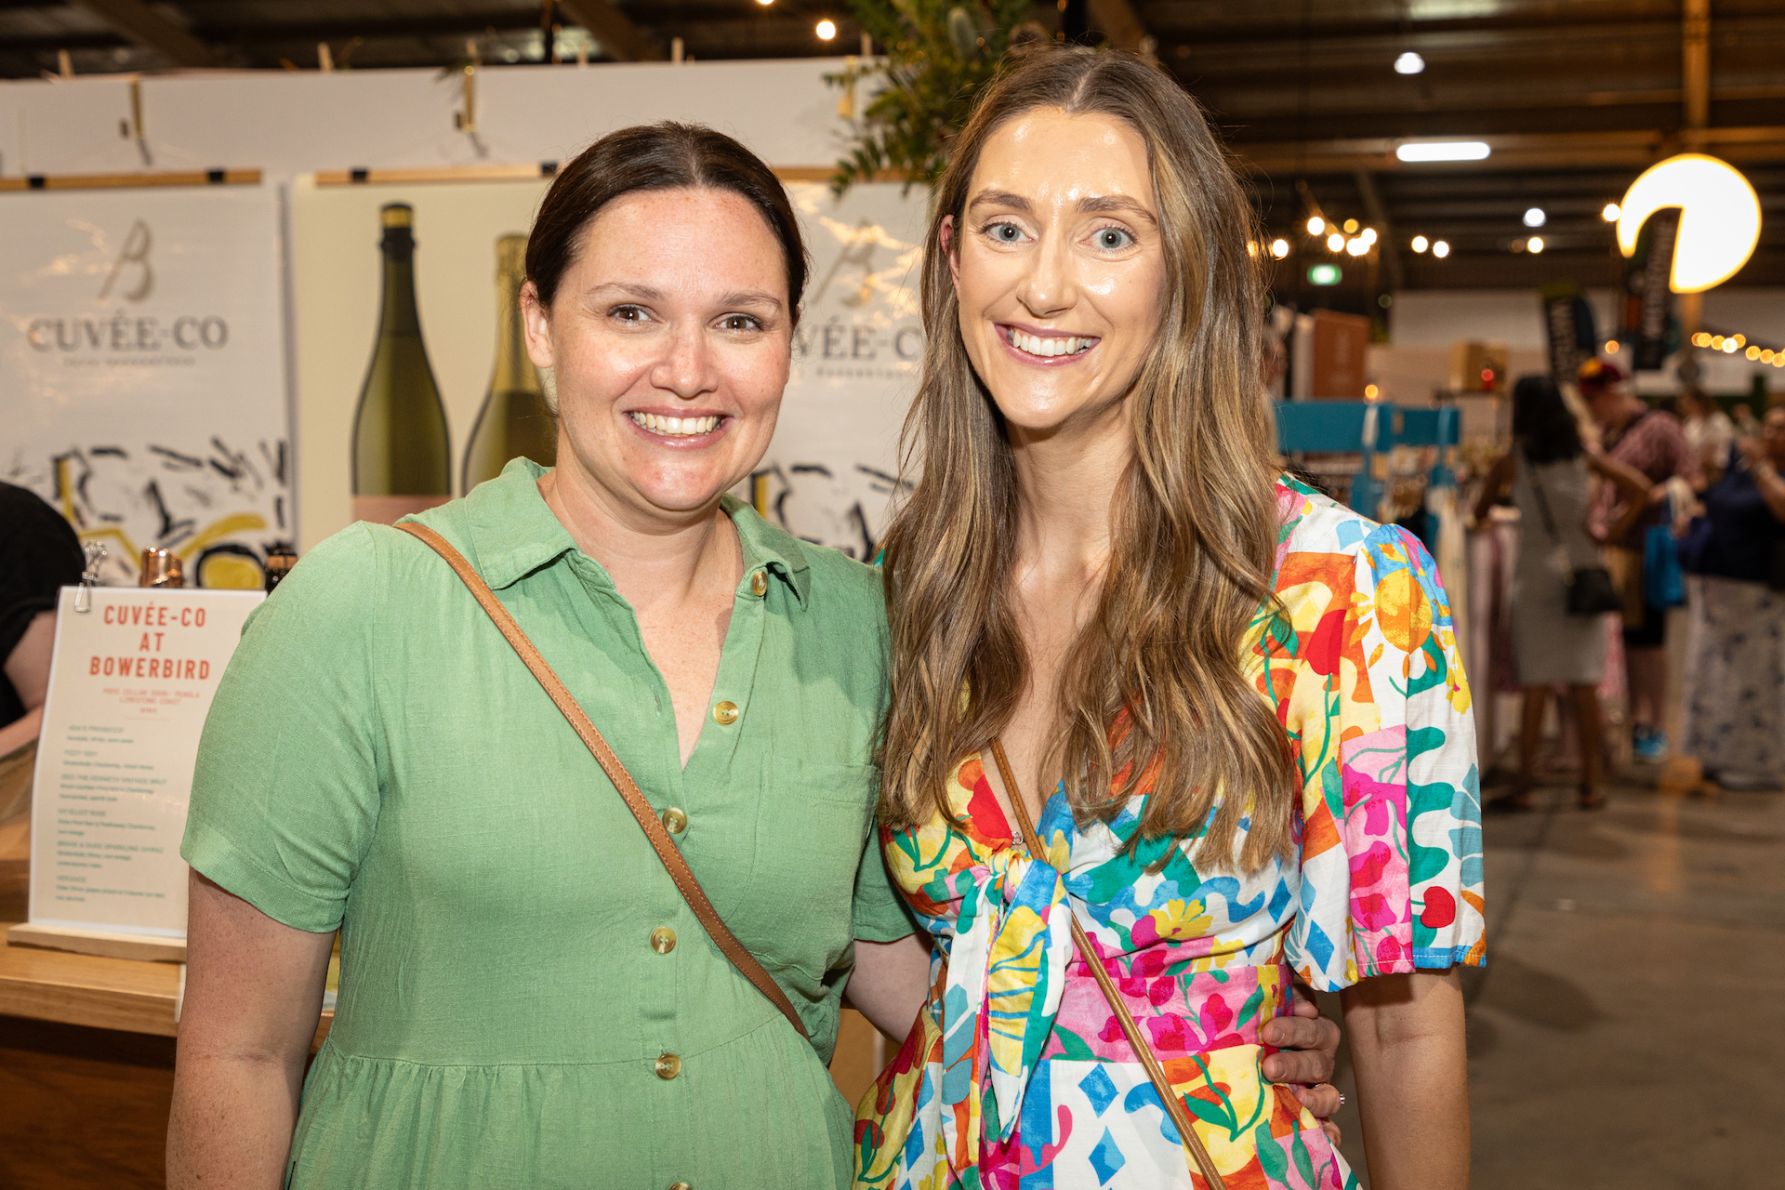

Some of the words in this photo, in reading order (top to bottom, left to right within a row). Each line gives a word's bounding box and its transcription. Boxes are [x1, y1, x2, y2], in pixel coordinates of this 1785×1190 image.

[793, 314, 923, 362] VÉE-C
[103, 602, 206, 627] CUVÉE-CO
[139, 632, 165, 652] AT
[89, 656, 211, 680] BOWERBIRD
